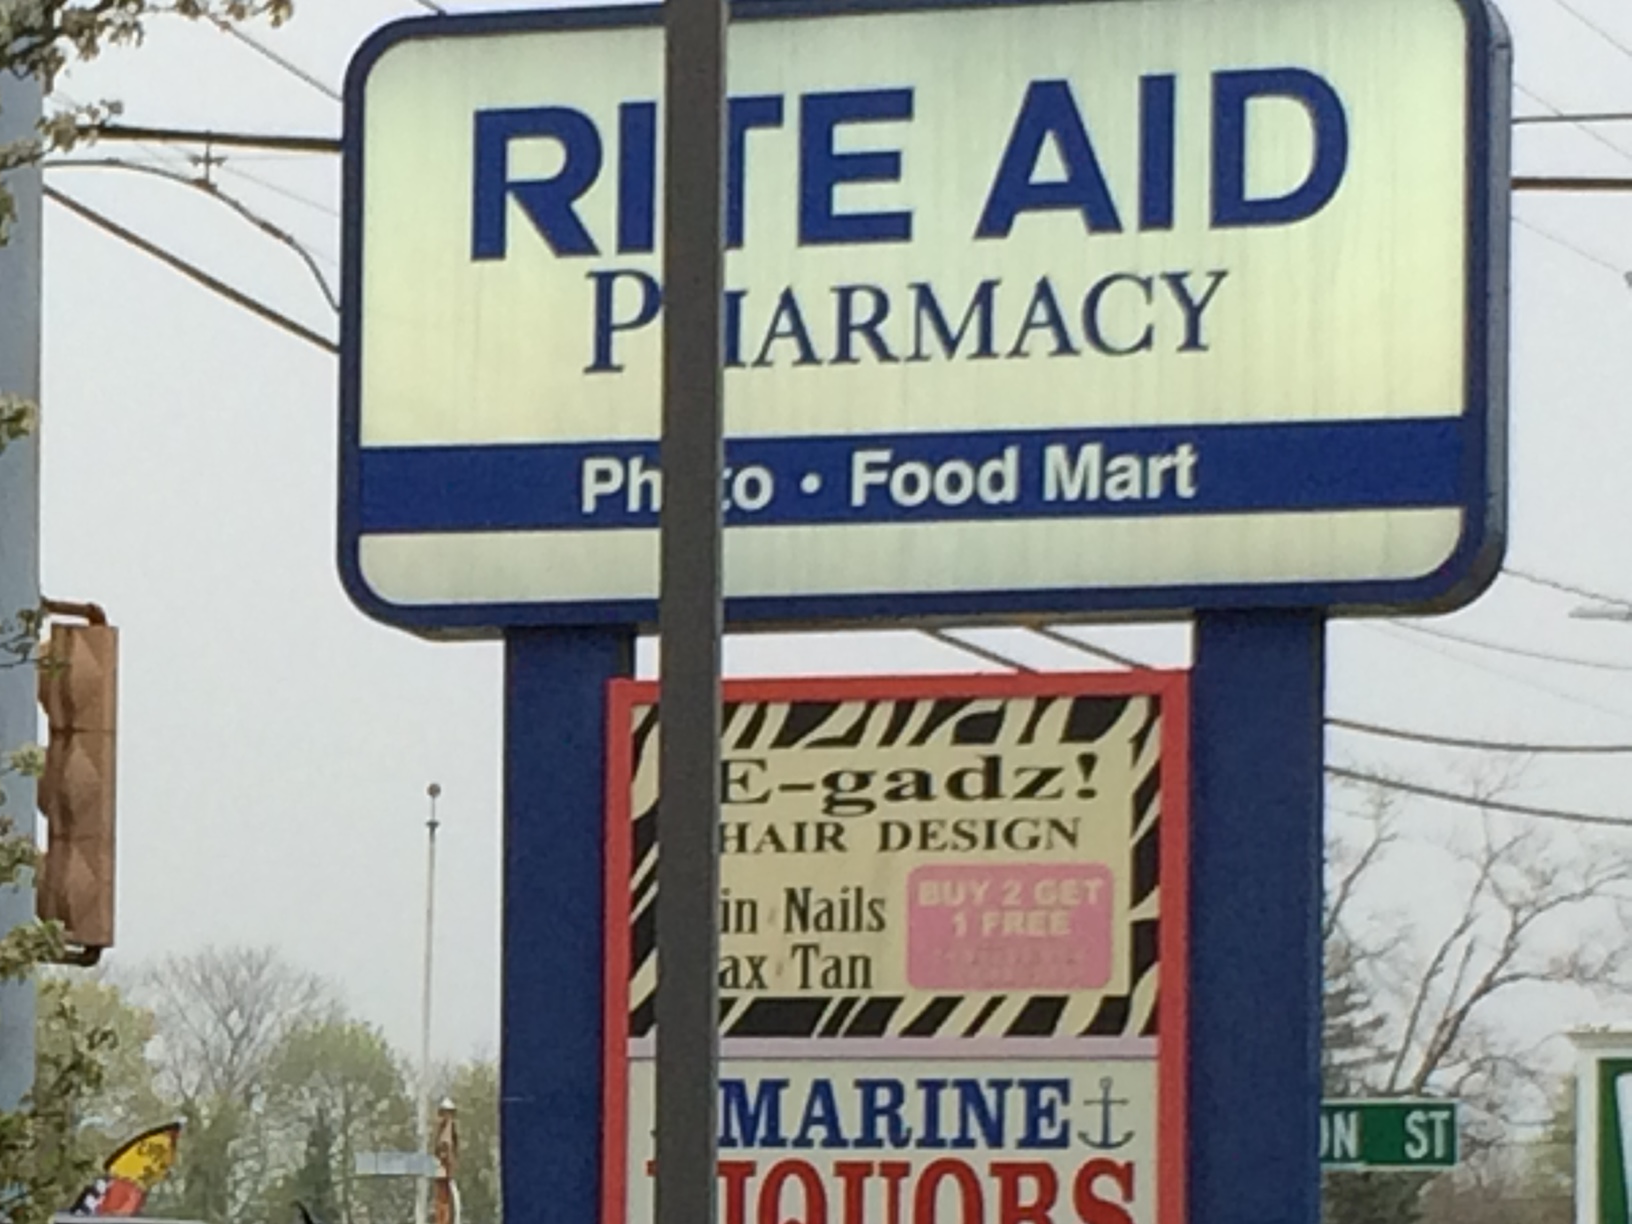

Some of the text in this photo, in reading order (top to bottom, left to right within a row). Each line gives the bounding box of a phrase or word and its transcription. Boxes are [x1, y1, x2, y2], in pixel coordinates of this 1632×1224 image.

[973, 67, 1350, 240] AID
[581, 440, 1199, 514] Pho Food Mart
[719, 752, 1101, 817] E-gadz!
[717, 816, 1082, 854] HAIR DESIGN
[783, 886, 887, 934] Nails
[919, 877, 1104, 908] BUY 2 GET
[981, 909, 1071, 938] FREE
[791, 943, 873, 991] Tan
[718, 1077, 1071, 1150] MARINE
[1404, 1110, 1452, 1159] ST
